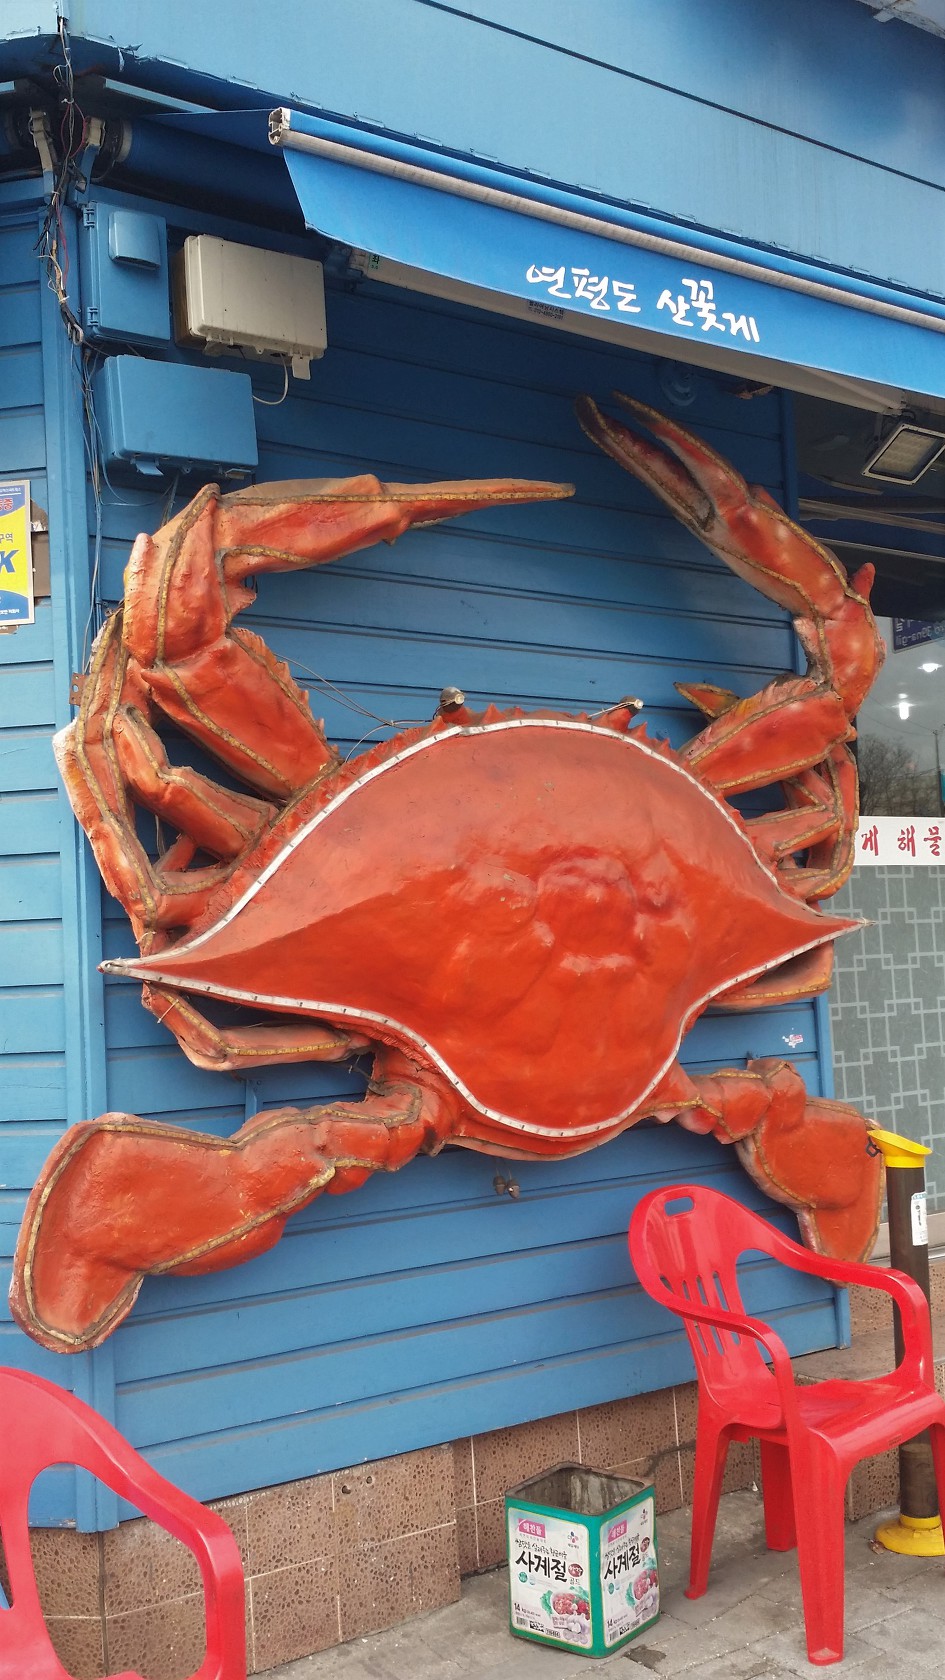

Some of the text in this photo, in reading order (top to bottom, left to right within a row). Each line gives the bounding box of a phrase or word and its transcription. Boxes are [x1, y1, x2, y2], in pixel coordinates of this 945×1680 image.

[526, 264, 760, 343] 연평도 산꽃게
[861, 824, 942, 857] 게 해물
[515, 1550, 568, 1583] 사계절
[604, 1543, 641, 1580] 사계절
[514, 1602, 520, 1611] 14
